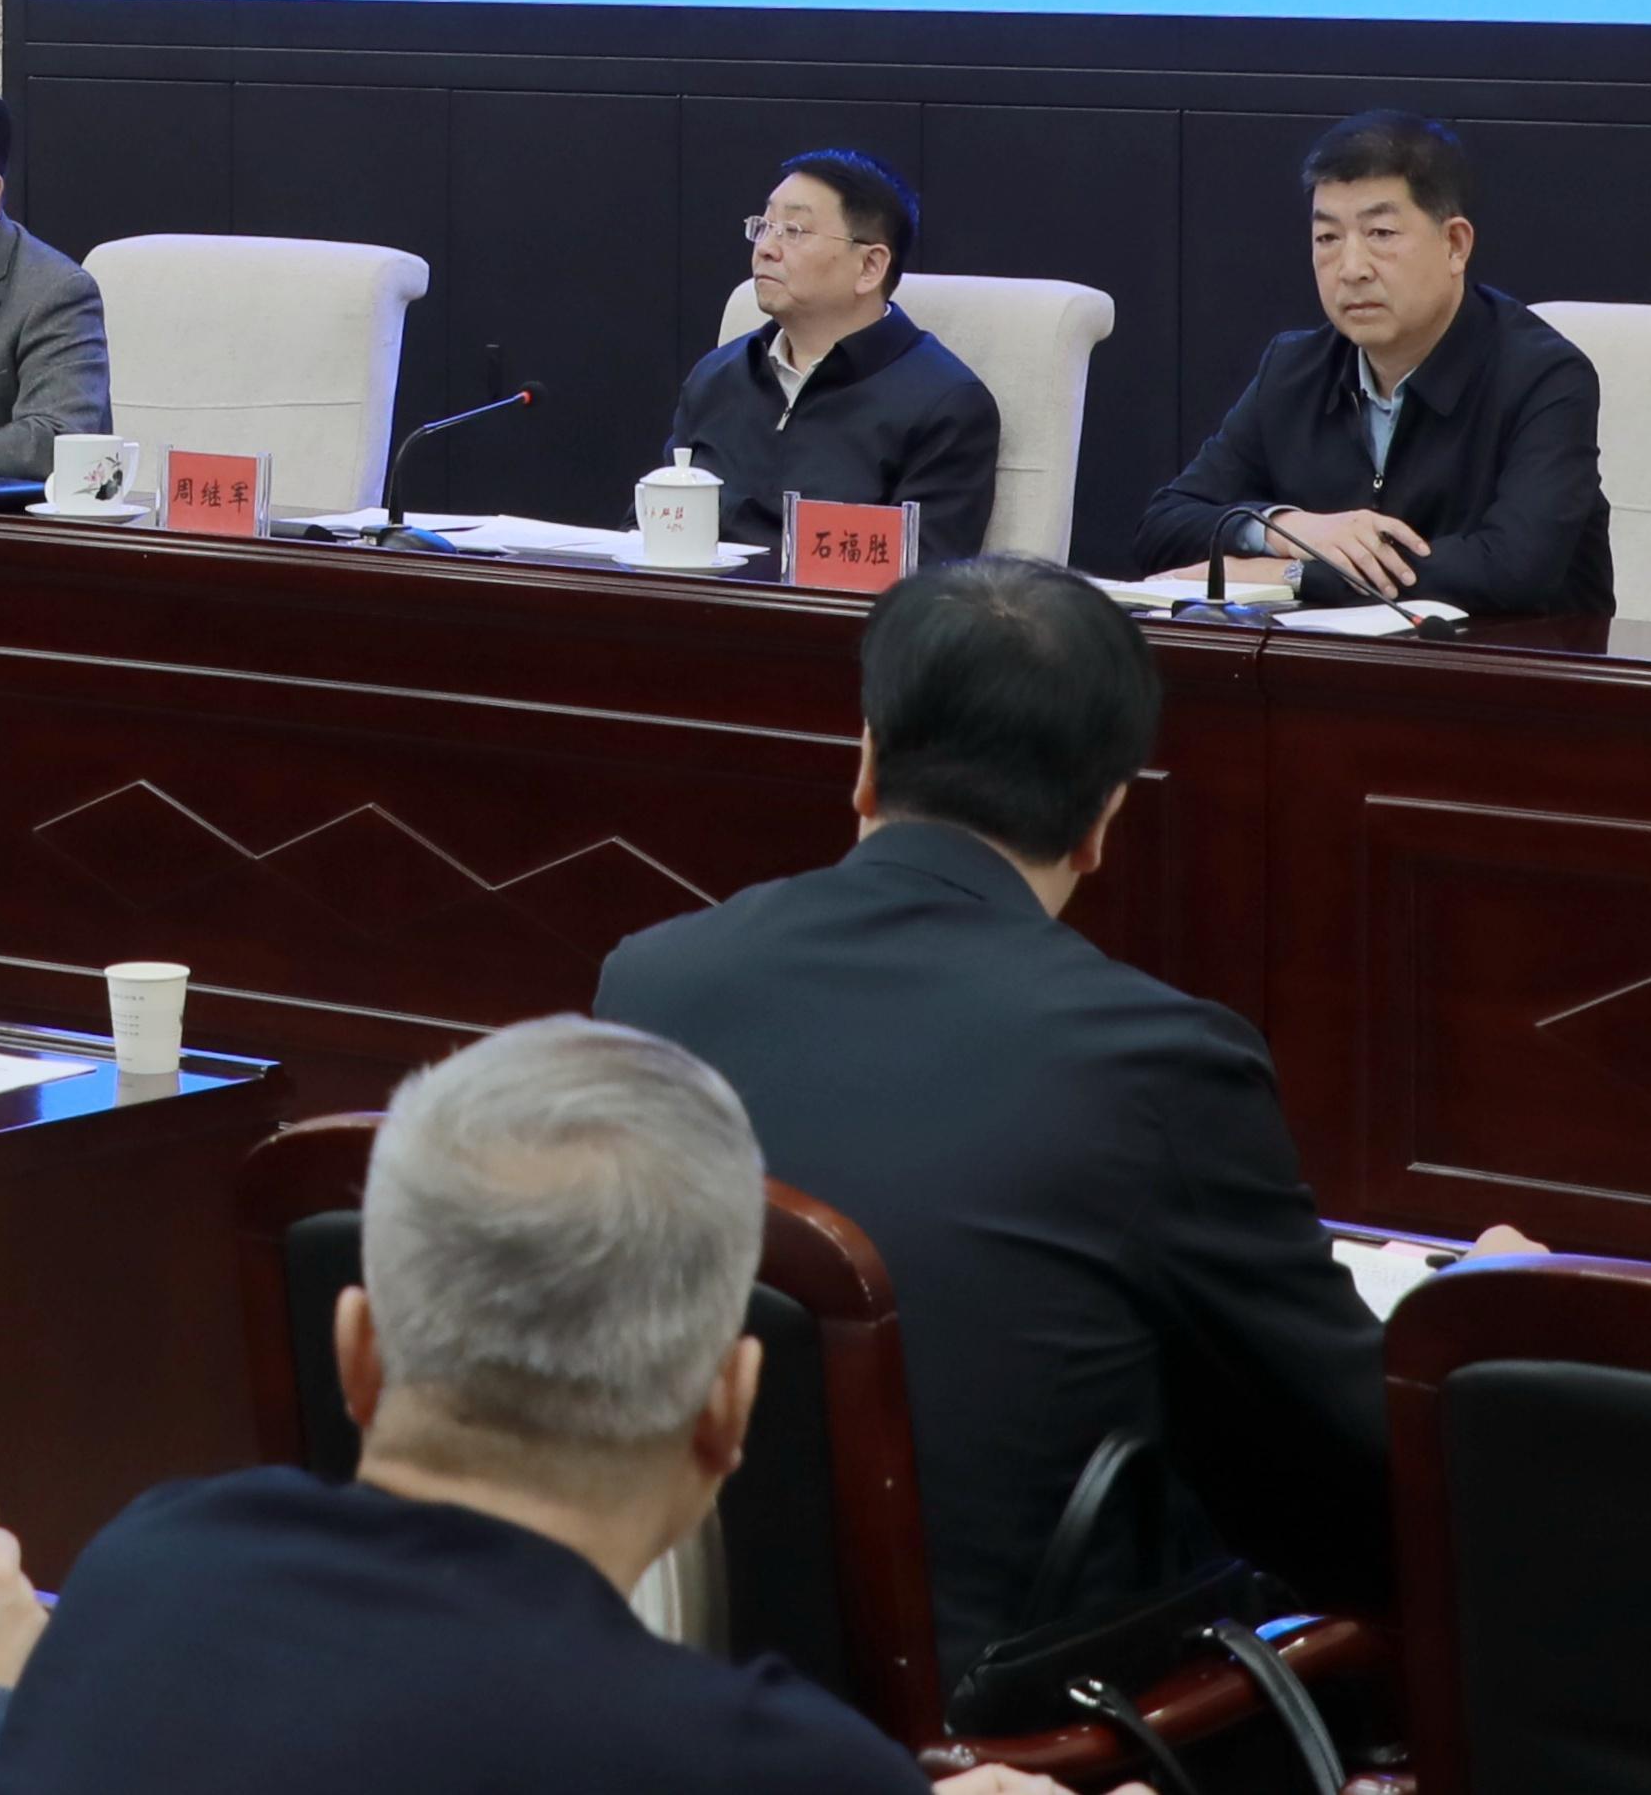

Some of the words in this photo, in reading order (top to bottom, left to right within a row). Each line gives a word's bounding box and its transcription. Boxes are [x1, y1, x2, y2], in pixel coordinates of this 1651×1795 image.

[173, 477, 249, 513] 周继军
[811, 529, 890, 565] 石福胜
